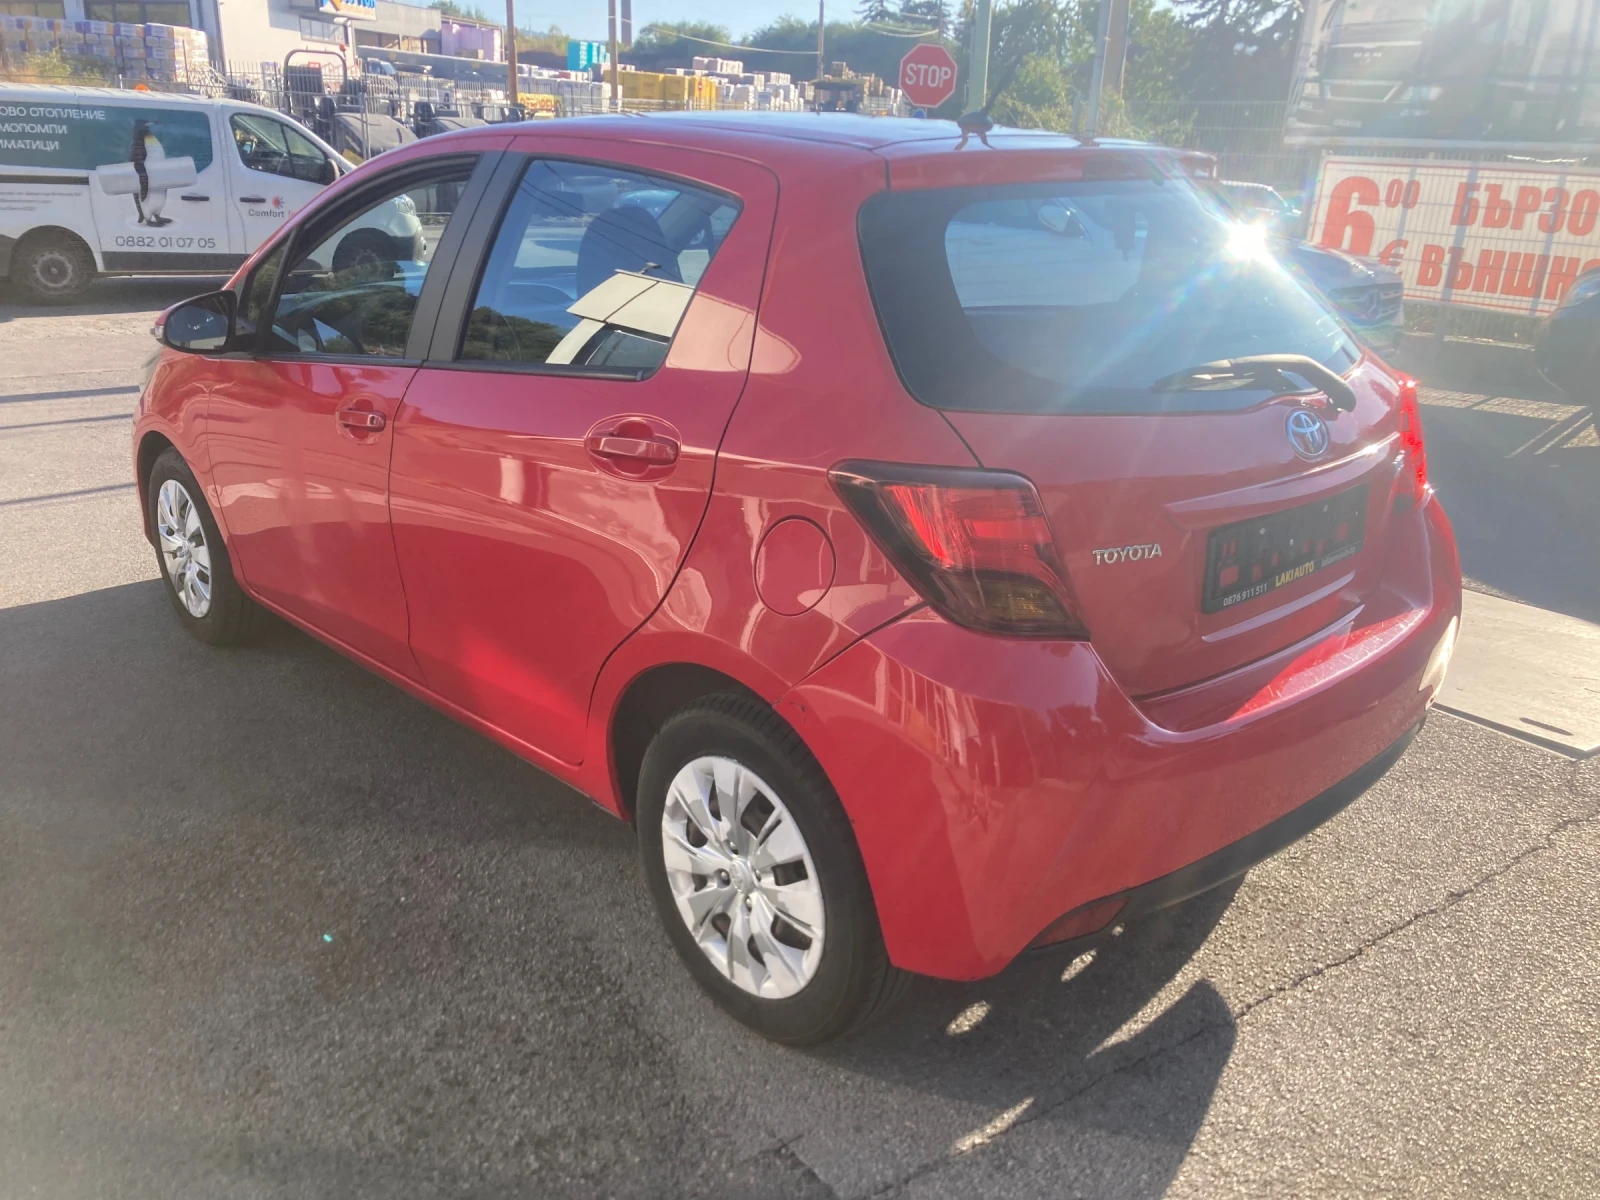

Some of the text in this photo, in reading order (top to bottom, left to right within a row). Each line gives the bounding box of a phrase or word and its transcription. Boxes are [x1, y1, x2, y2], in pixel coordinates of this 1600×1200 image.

[905, 63, 952, 88] STOP
[29, 107, 106, 120] ОТОПЛЕНИЕ
[248, 208, 285, 218] Comfort
[1450, 181, 1600, 237] БЪРЗО
[115, 235, 216, 249] 0882 01 07 05
[1416, 243, 1600, 301] ВЪНШН
[1092, 543, 1163, 566] TOYOTA
